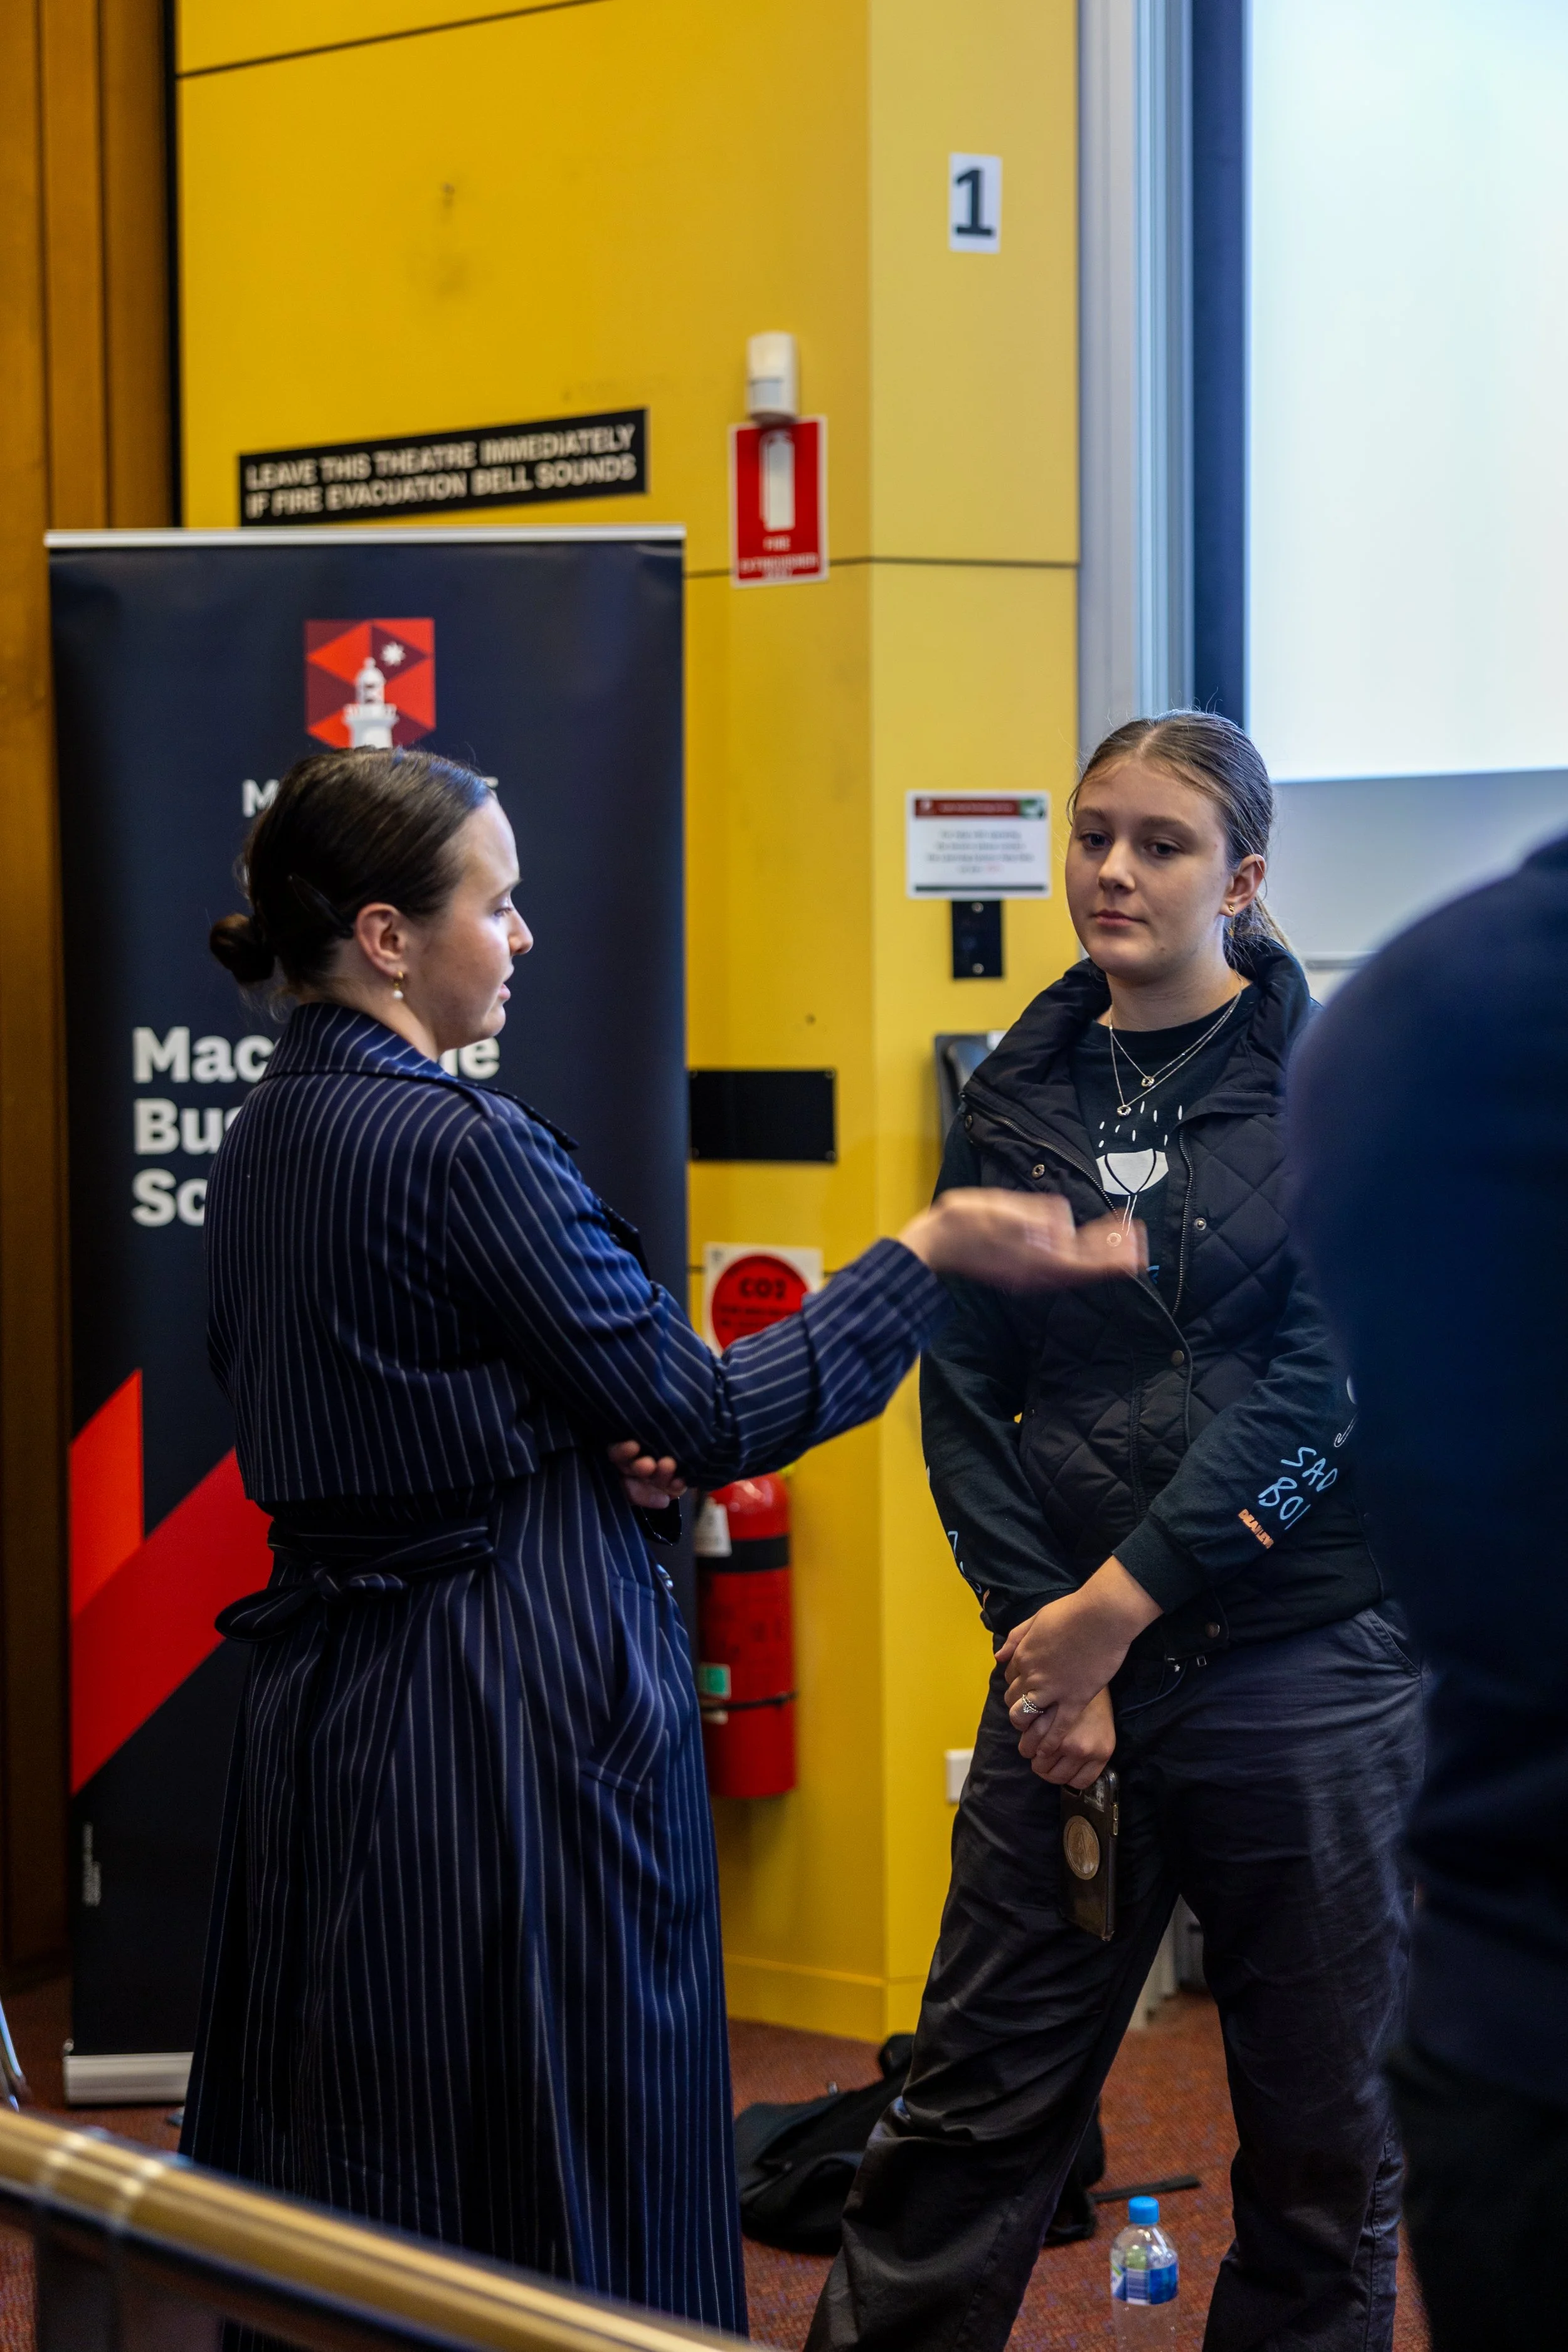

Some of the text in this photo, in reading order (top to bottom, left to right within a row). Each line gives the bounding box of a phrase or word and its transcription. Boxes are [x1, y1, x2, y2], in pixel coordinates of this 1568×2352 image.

[955, 167, 994, 238] 1
[245, 423, 635, 491] LEAVE THIS THEATRE IMMEDIATELY
[245, 453, 637, 519] IF FIRE EVACUATION BELL SOUNDS
[1281, 1447, 1338, 1492] SAD
